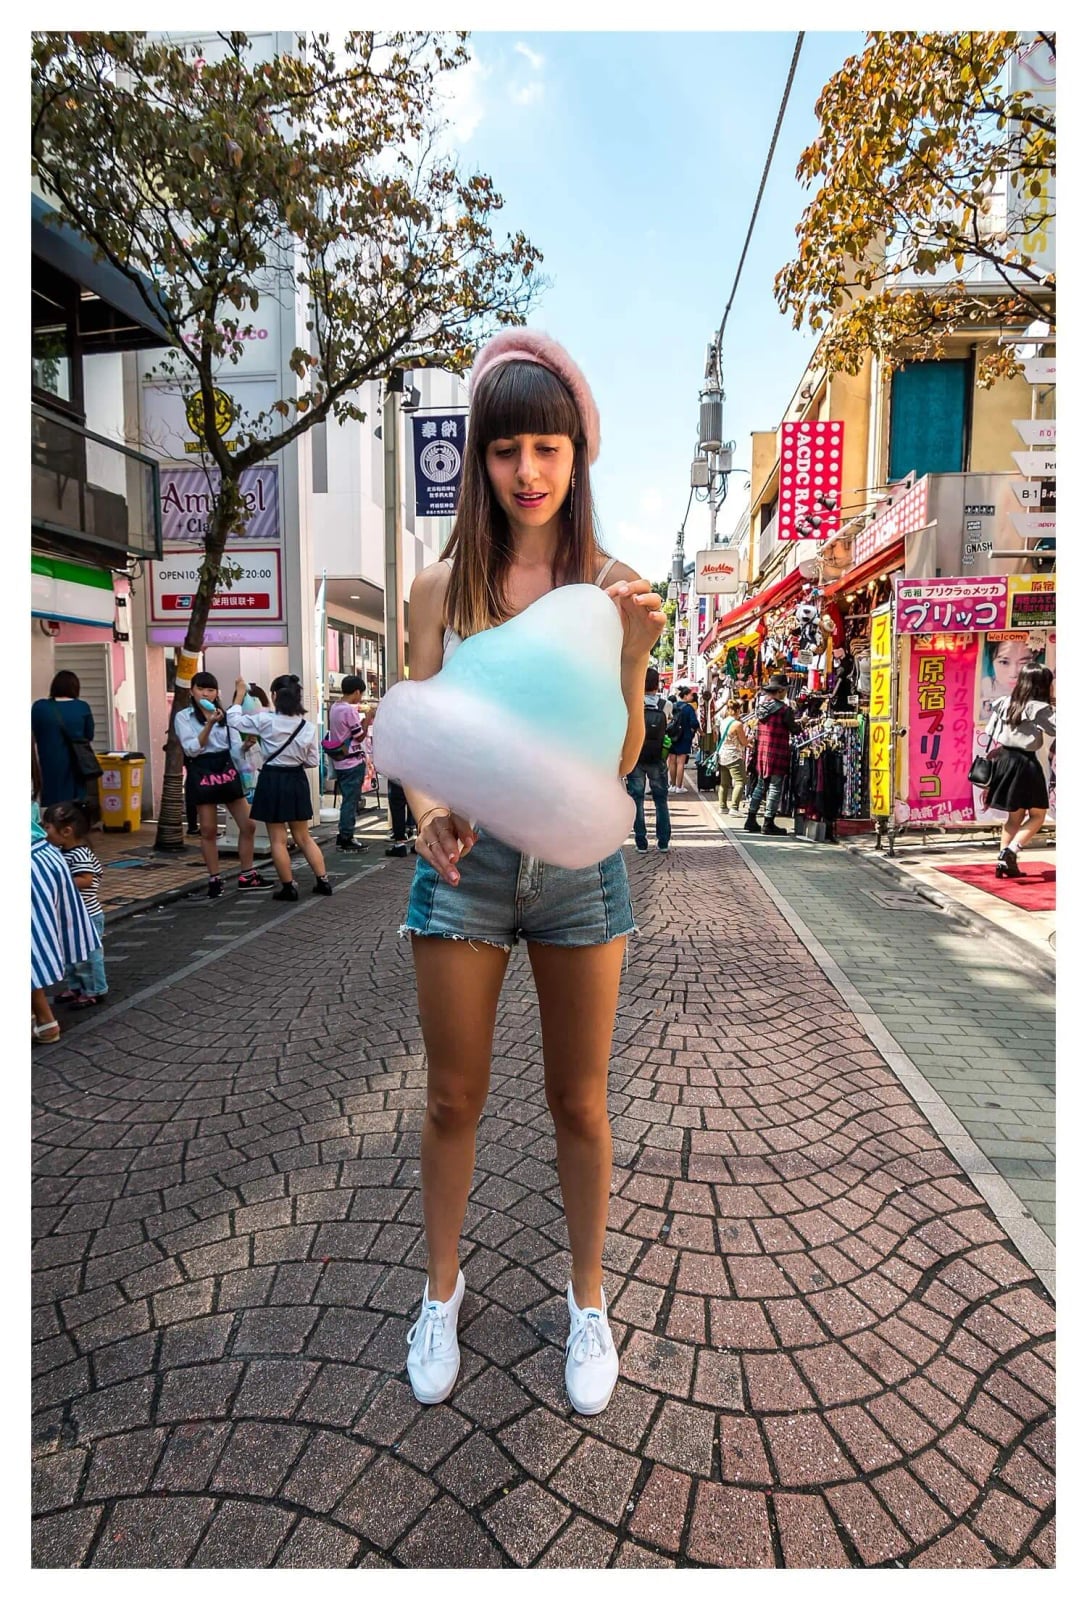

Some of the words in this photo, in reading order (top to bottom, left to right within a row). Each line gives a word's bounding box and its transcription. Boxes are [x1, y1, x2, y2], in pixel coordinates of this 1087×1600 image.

[796, 432, 812, 485] ACDC
[966, 541, 993, 554] GNASH
[904, 602, 998, 630] プリッコ
[918, 655, 947, 798] 原宿プリッコ
[200, 769, 237, 786] ANAP
